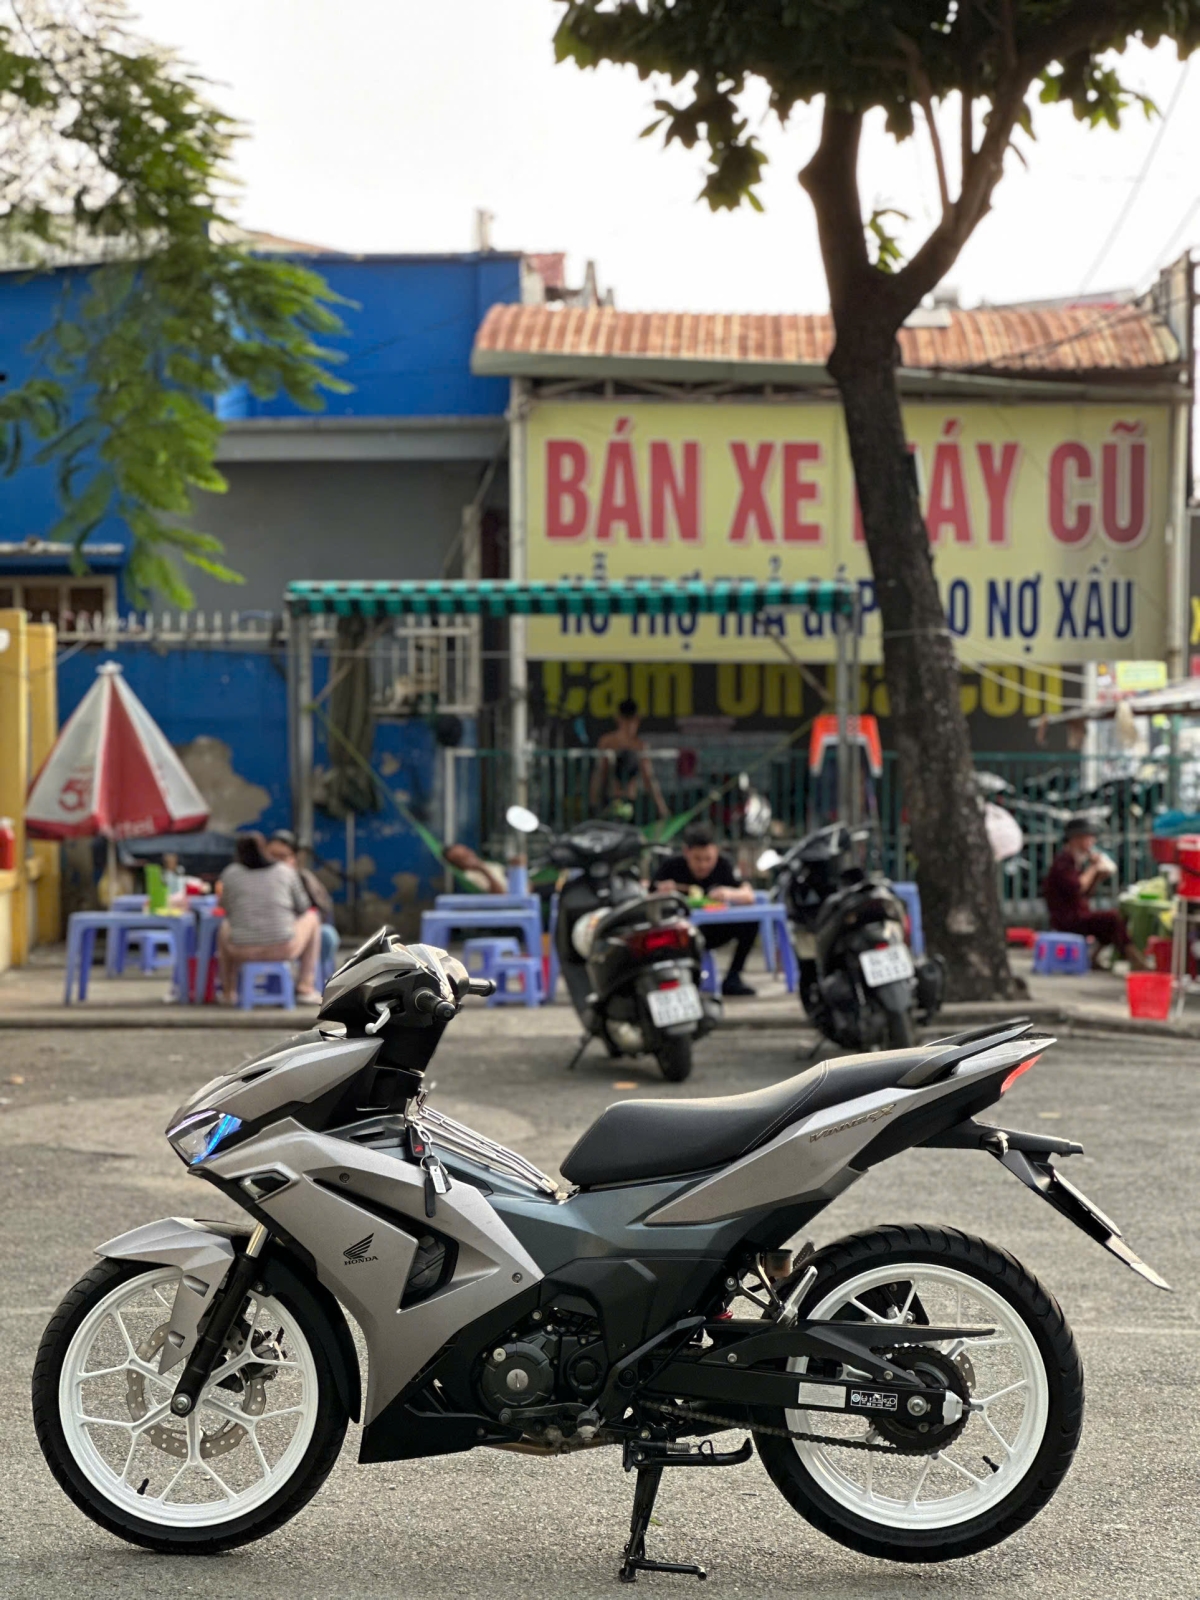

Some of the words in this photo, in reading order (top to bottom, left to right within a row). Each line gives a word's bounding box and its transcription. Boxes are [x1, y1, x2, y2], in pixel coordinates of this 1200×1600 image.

[546, 416, 700, 541] BÁN
[728, 440, 822, 542] XE
[853, 417, 1020, 543] ÁY
[1048, 419, 1146, 544] CŨ
[986, 573, 1042, 654] NỢ
[1056, 555, 1133, 638] XẤU
[344, 1256, 379, 1266] HONDA
